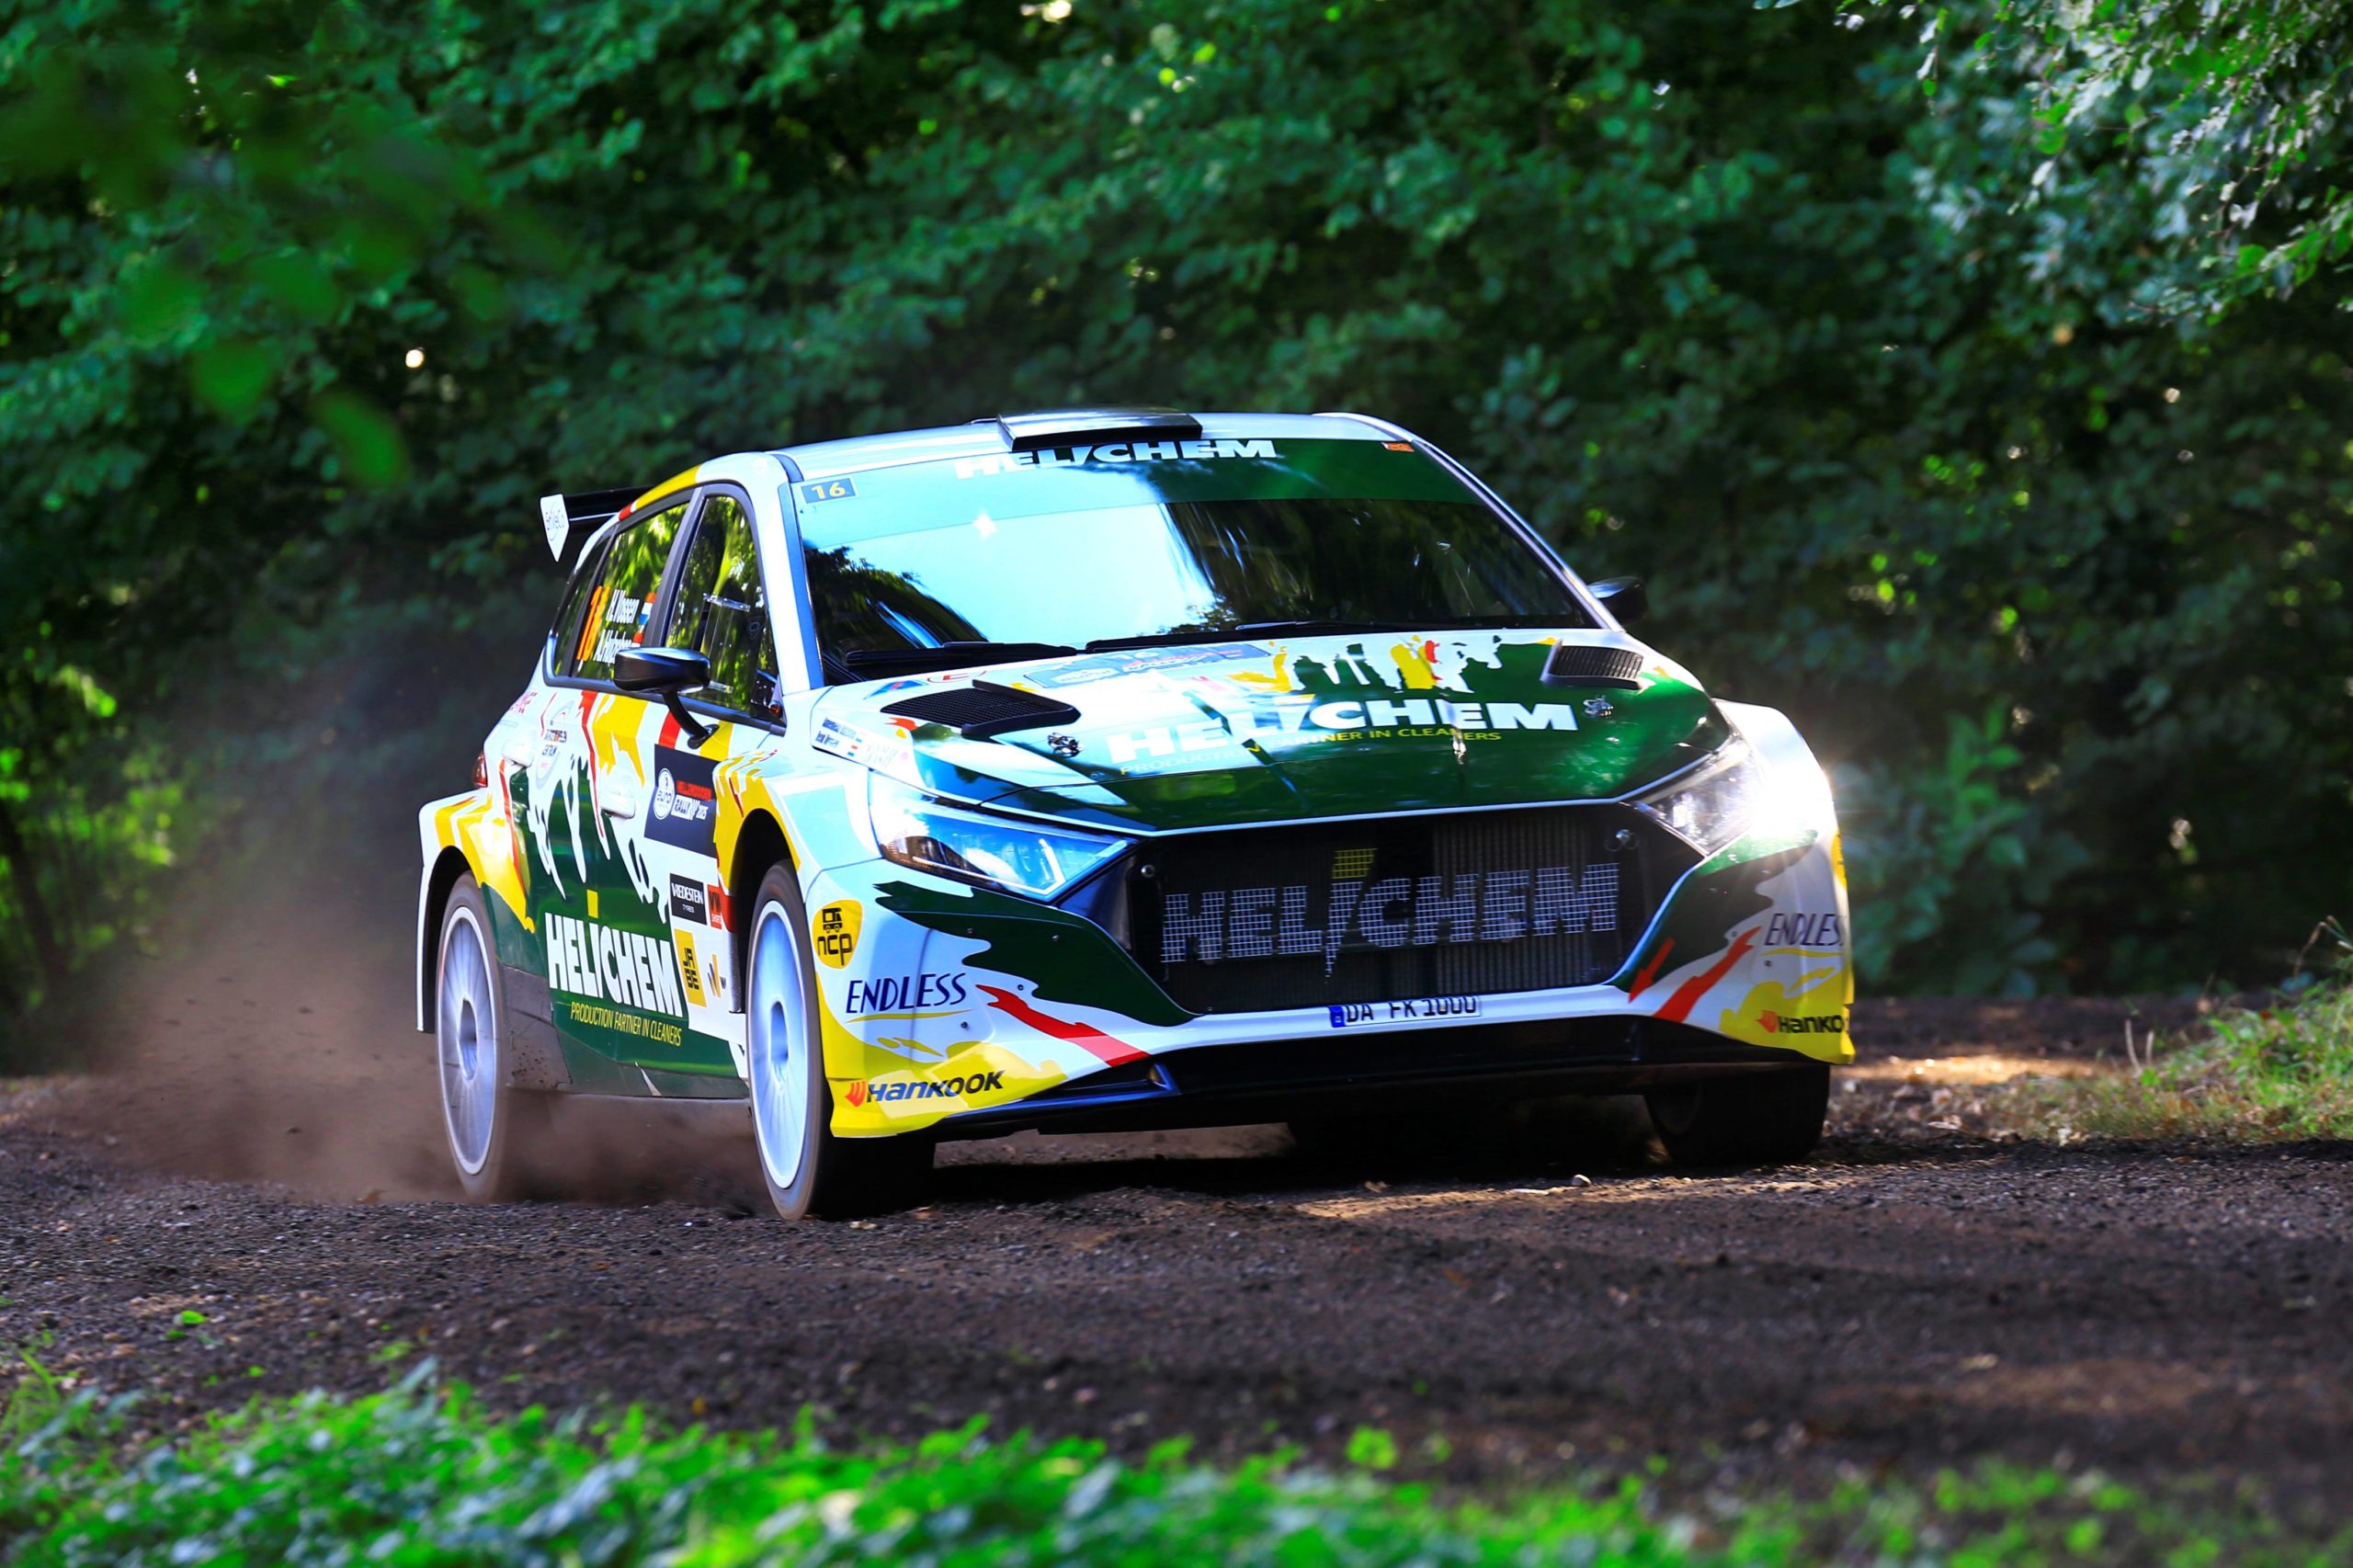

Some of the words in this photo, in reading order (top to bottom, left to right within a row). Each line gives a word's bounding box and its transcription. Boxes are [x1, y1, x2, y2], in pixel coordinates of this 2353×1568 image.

[812, 482, 846, 500] 16
[1105, 695, 1578, 765] HELICHEM
[1370, 729, 1392, 739] IN
[1397, 726, 1502, 741] CLEANERS
[1160, 848, 1620, 977] HELICHEM
[1764, 912, 1844, 947] ENDLES
[545, 889, 683, 1017] HELICHEM
[846, 972, 966, 1014] ENDLESS
[570, 1001, 614, 1028] PRODUCTION
[642, 1018, 651, 1038] IN
[650, 1020, 682, 1046] CLEANERS
